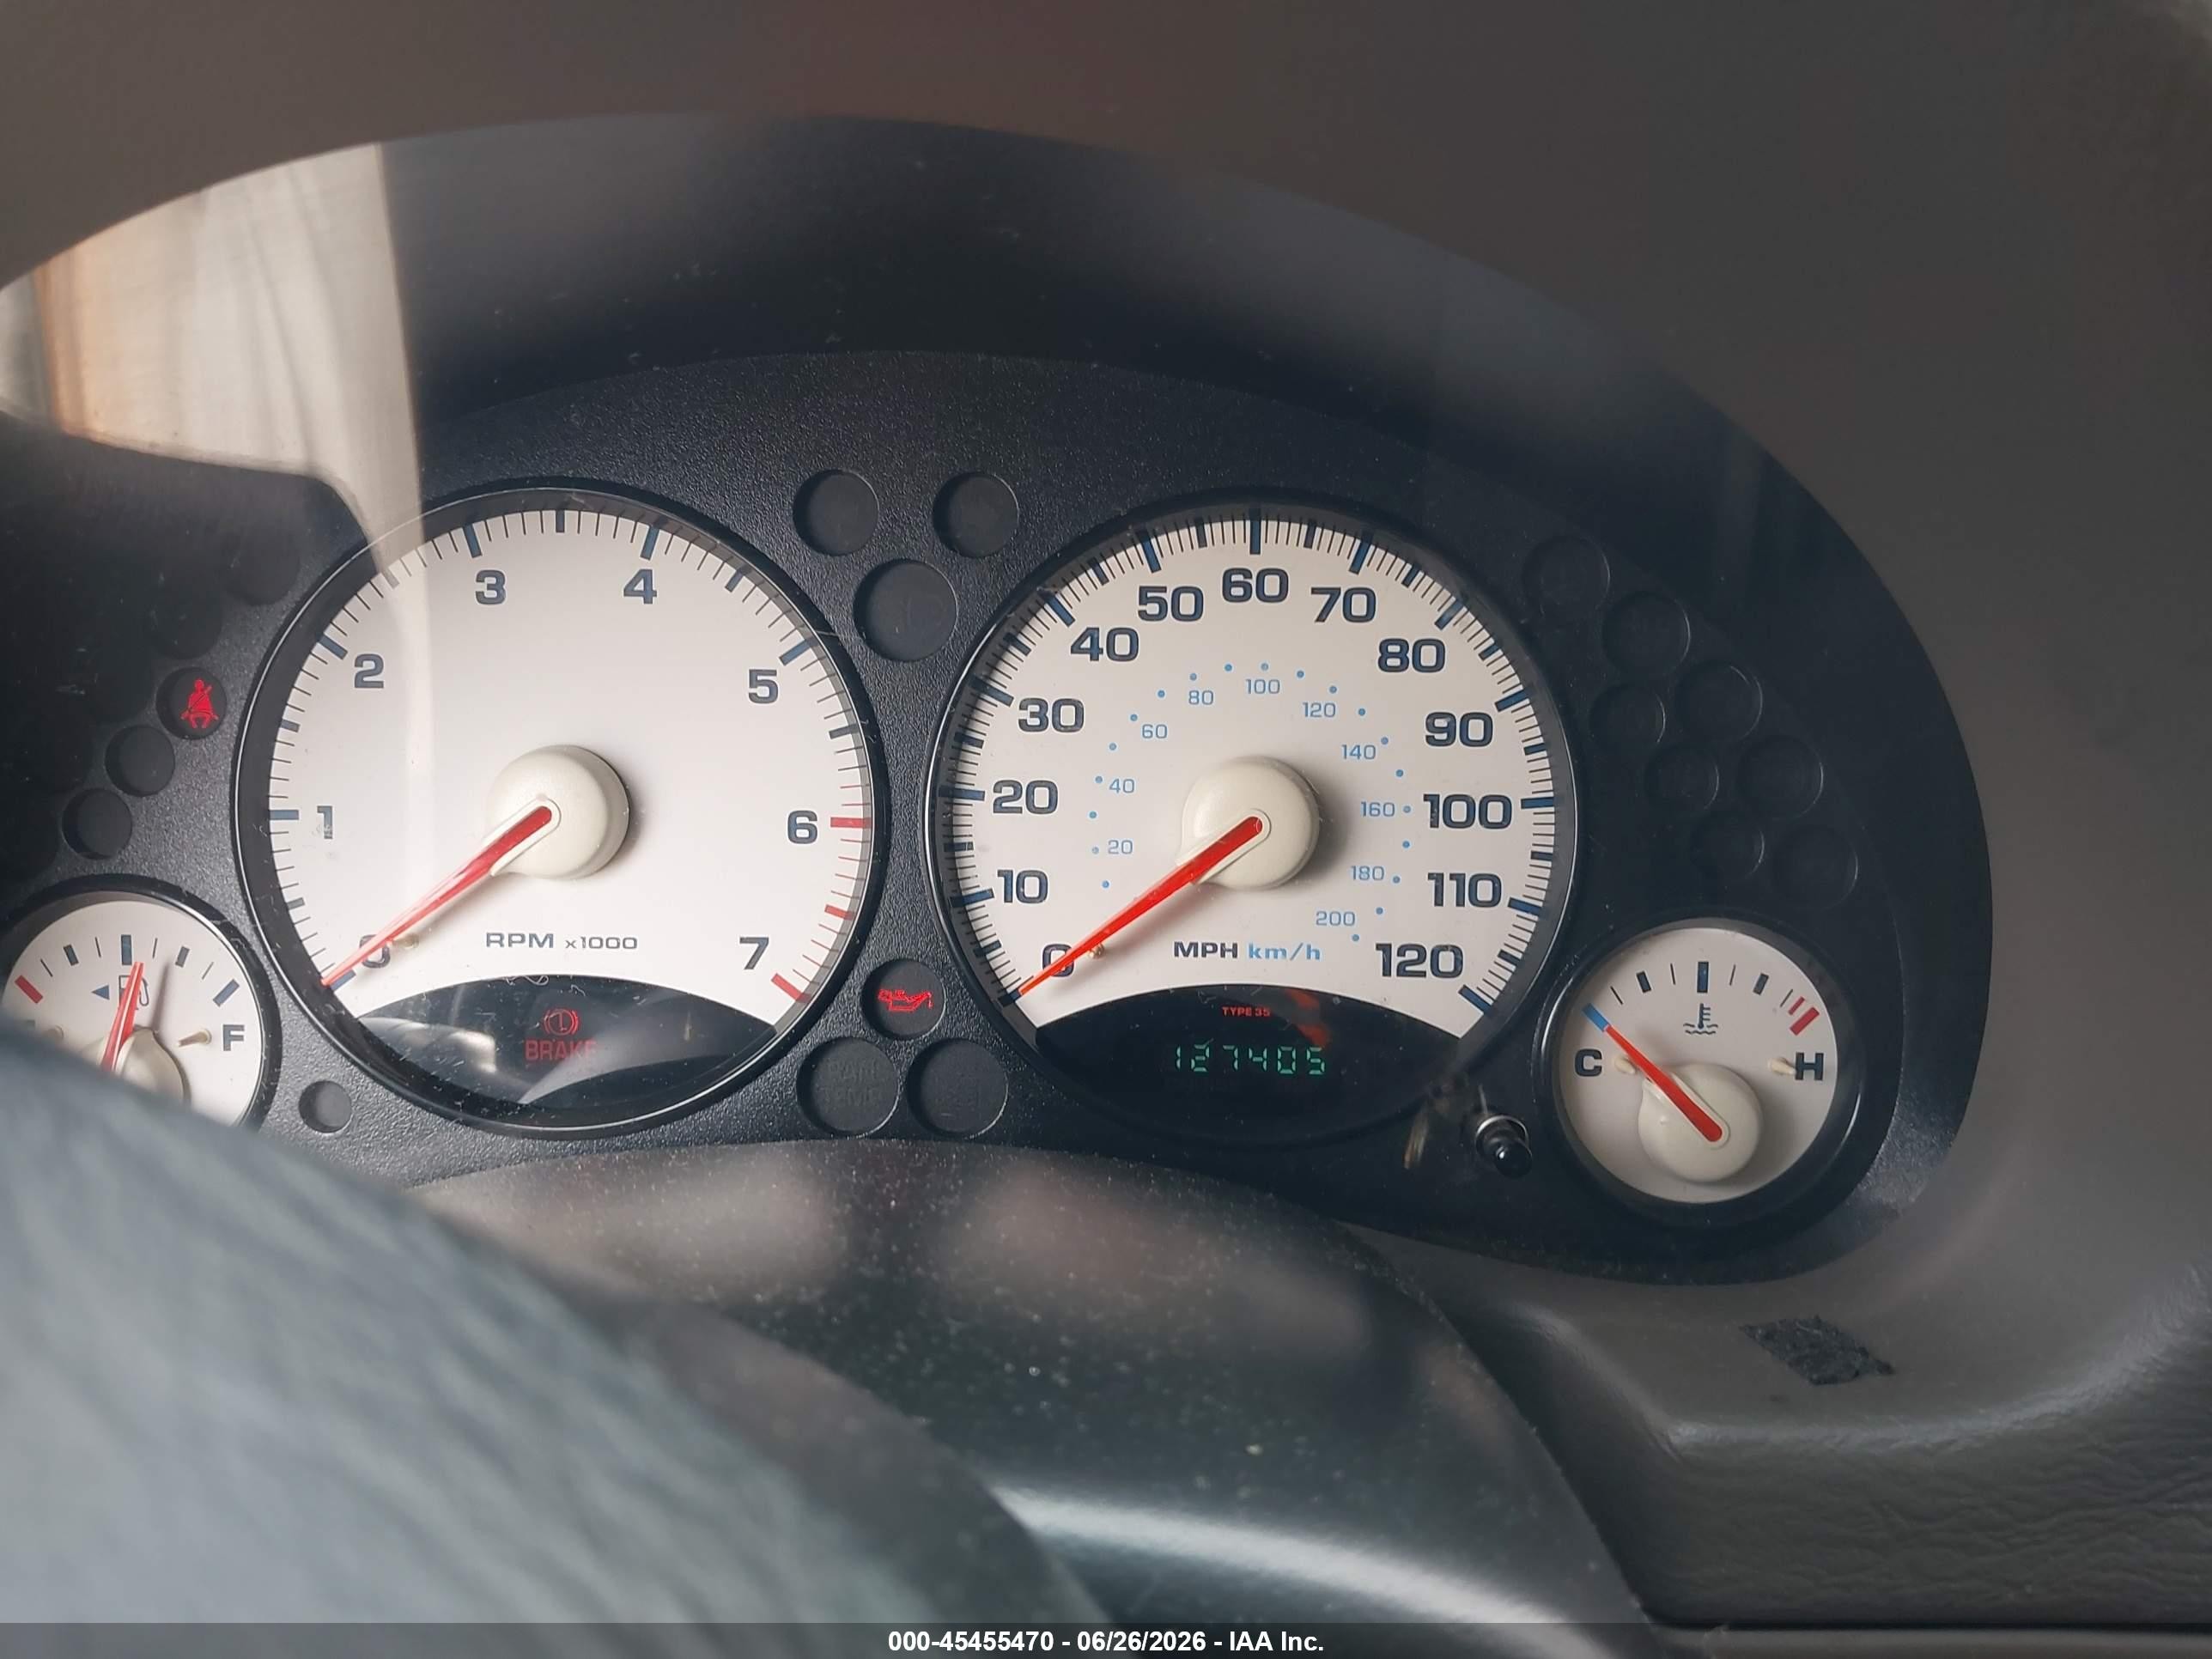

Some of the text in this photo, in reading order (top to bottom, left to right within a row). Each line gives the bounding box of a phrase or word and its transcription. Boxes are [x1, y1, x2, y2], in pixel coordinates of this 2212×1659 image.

[475, 569, 507, 605] 3
[623, 568, 658, 605] 4
[1222, 568, 1289, 603] 60
[1138, 586, 1204, 622] 50
[1310, 586, 1376, 623] 70
[1071, 627, 1139, 662] 40
[1377, 638, 1446, 672] 80
[354, 653, 384, 689] 2
[748, 669, 779, 704] 5
[1245, 679, 1280, 695] 100
[1018, 697, 1085, 732] 30
[1188, 690, 1213, 705] 80
[1303, 702, 1336, 718] 120
[1141, 724, 1168, 739] 60
[1425, 712, 1493, 747] 90
[1341, 744, 1376, 760] 140
[993, 780, 1058, 814] 20
[1109, 778, 1135, 793] 40
[317, 805, 333, 840] 1
[1361, 802, 1395, 817] 160
[1423, 793, 1512, 830] 100
[787, 810, 818, 845] 6
[1107, 840, 1133, 854] 20
[997, 870, 1048, 904] 10
[1351, 866, 1385, 881] 180
[1427, 872, 1502, 908] 110
[1316, 911, 1355, 927] 200
[359, 934, 391, 968] 0
[485, 933, 638, 950] RPM x1000
[739, 937, 769, 969] 7
[1174, 941, 1321, 960] MPH km/h
[1042, 944, 1074, 977] 0
[1376, 943, 1464, 978] 120
[223, 1024, 244, 1051] F
[1176, 1044, 1325, 1075] 127405
[1575, 1049, 1602, 1077] C
[1795, 1052, 1824, 1081] H
